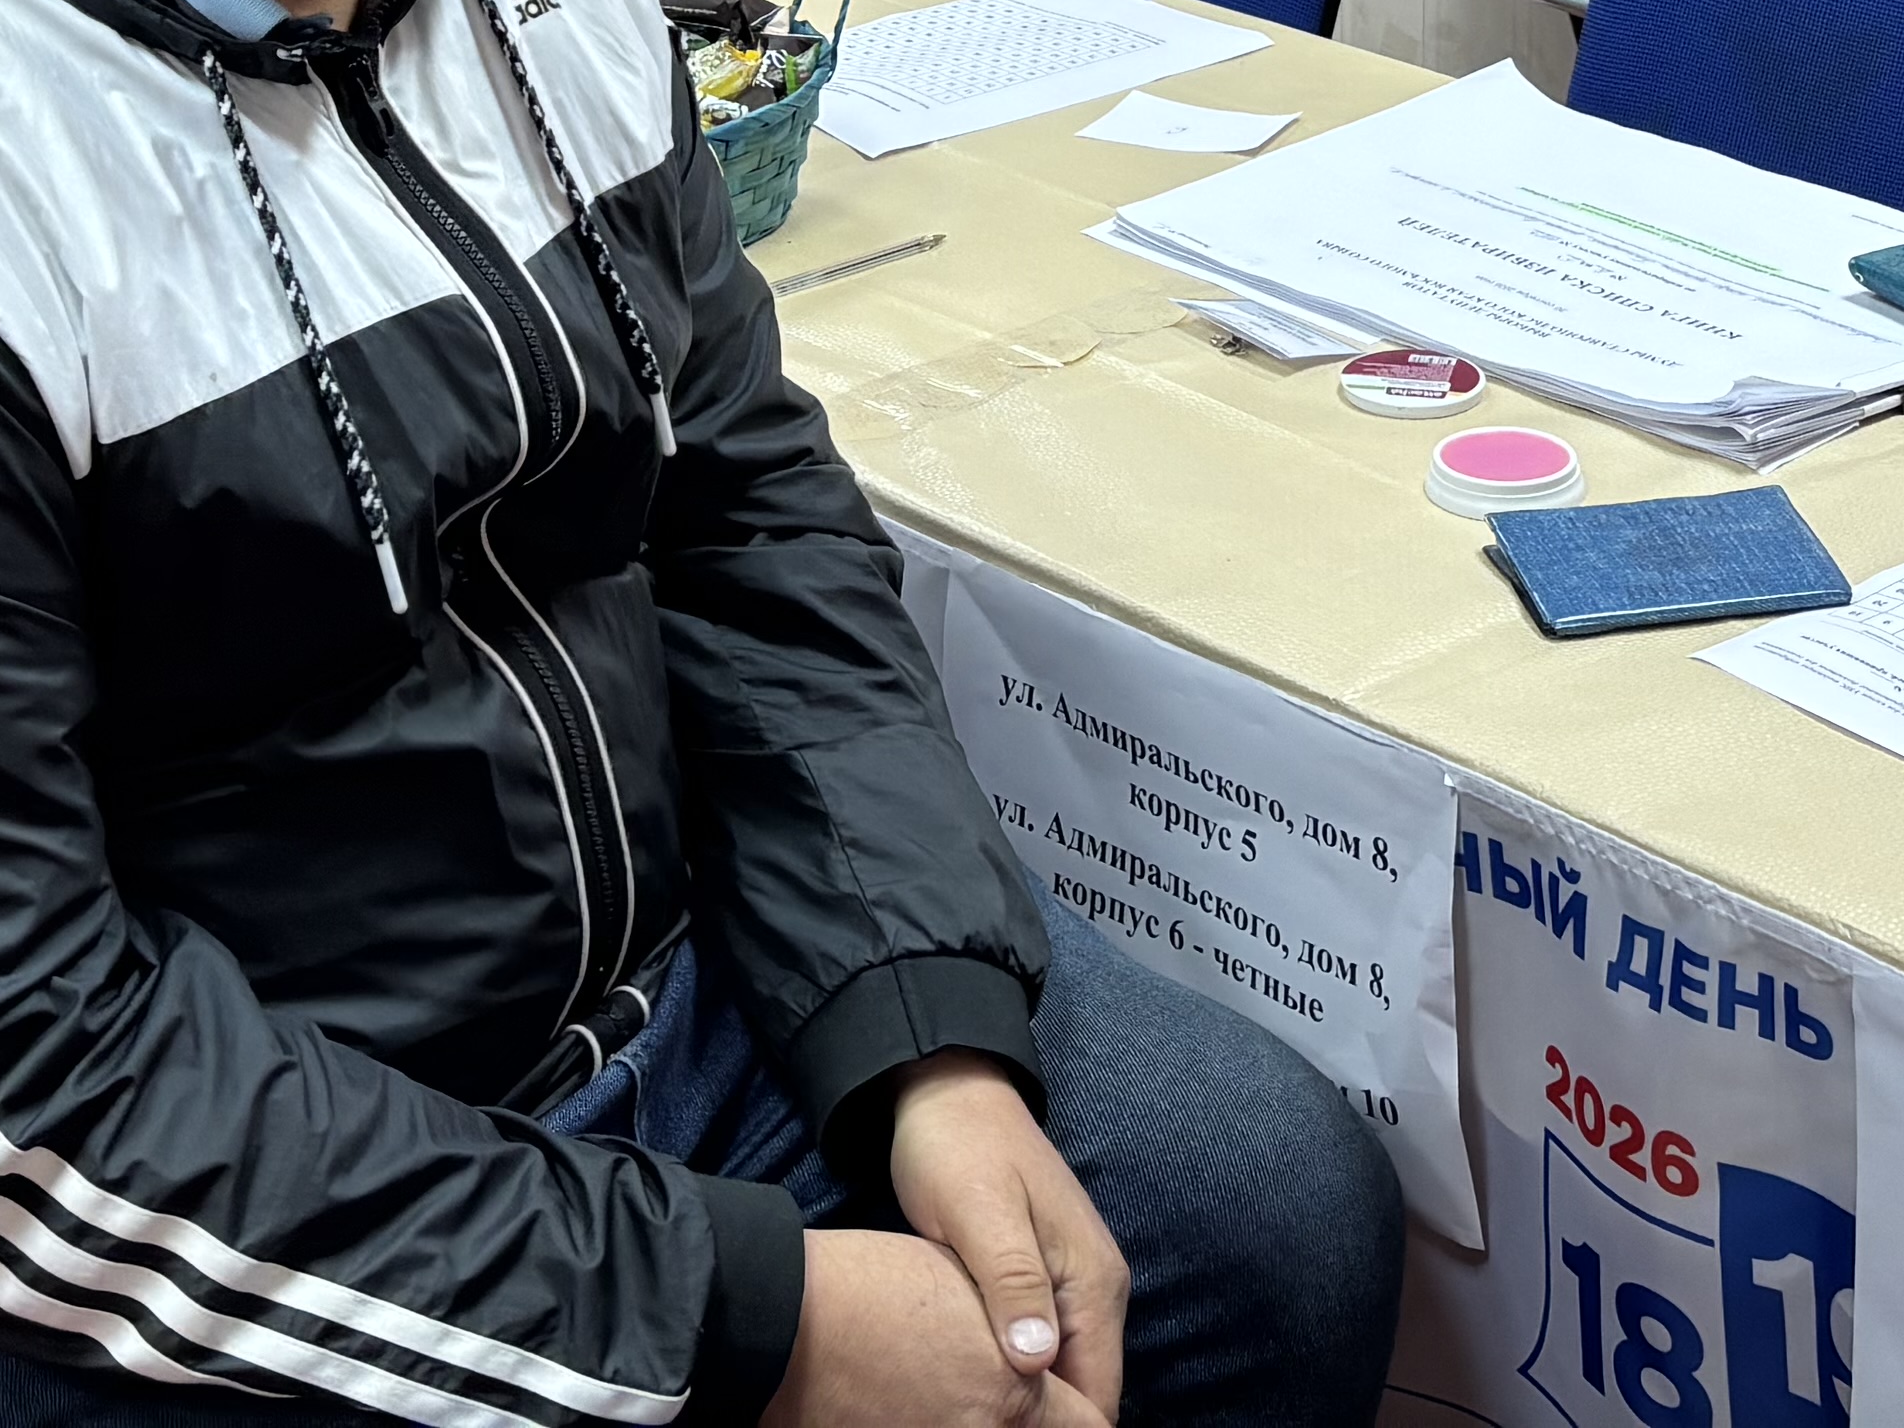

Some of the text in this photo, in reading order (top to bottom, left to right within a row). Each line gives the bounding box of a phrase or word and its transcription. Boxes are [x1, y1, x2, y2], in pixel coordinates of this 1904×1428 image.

[998, 674, 1399, 883] ул. Адмиральского, дом 8,
[1128, 782, 1258, 863] корпус 5
[993, 793, 1391, 1012] ул. Адмиральского, дом 8,
[1052, 871, 1160, 940] корпус
[1169, 919, 1186, 951] 6
[1213, 946, 1325, 1024] четные
[1605, 913, 1834, 1061] ДЕНЬ
[1361, 1088, 1400, 1126] 10
[1545, 1044, 1700, 1198] 2026
[1561, 1236, 1714, 1428] 18
